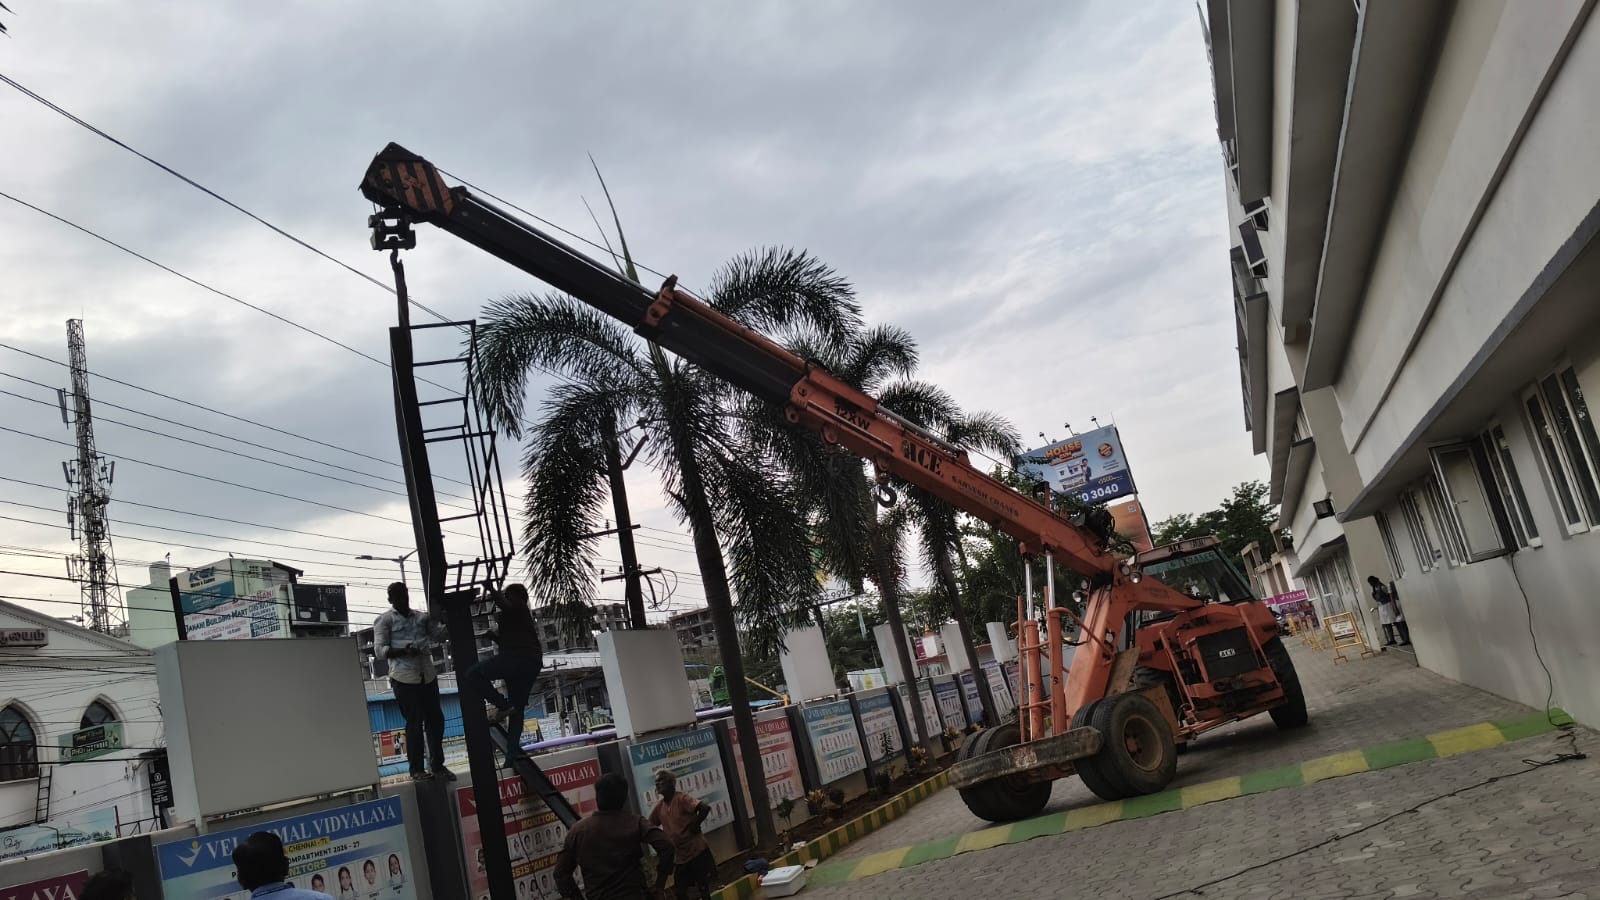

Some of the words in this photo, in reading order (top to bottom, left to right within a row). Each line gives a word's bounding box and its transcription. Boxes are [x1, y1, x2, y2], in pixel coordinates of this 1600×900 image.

[834, 406, 871, 430] 12XW
[1045, 440, 1082, 458] HOUSE
[902, 440, 944, 478] ACE
[1090, 484, 1118, 499] 3040
[185, 621, 206, 633] JANANI
[231, 609, 248, 618] MART
[312, 805, 396, 835] VIDYALAYA
[288, 840, 316, 852] CHENNAI
[288, 849, 331, 865] OMPARTMENT
[289, 860, 327, 876] NITORS
